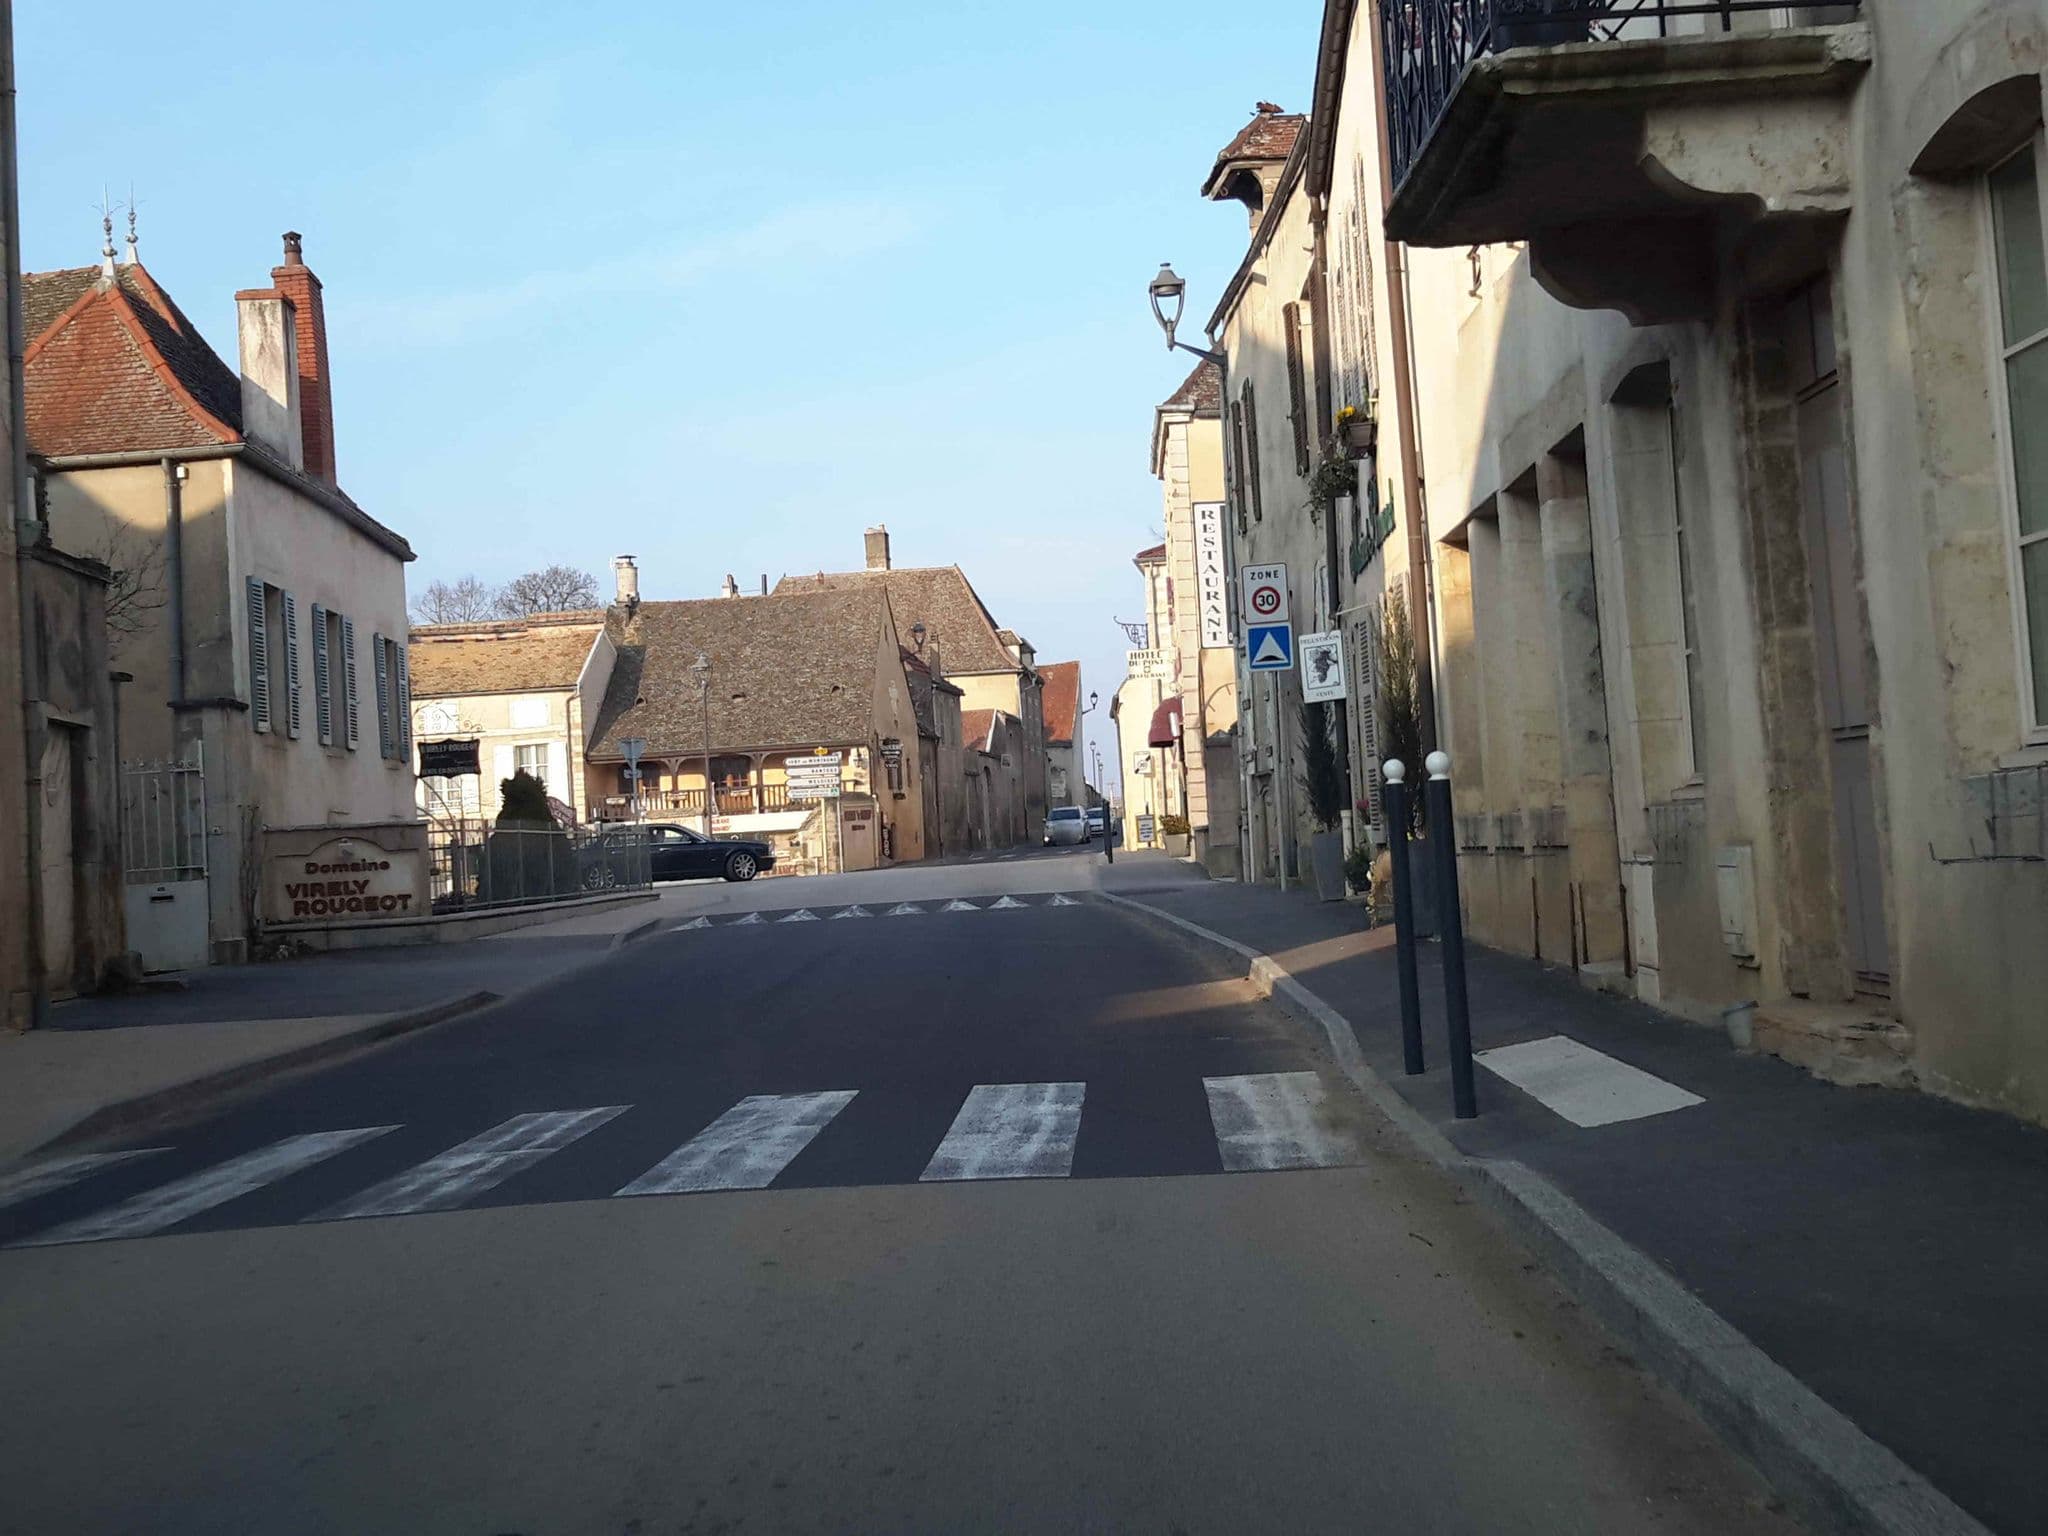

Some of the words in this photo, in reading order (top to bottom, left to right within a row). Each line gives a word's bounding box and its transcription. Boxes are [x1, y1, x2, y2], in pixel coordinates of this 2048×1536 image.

[1201, 510, 1222, 641] RESTAURANT
[1250, 570, 1279, 580] ZONE
[1258, 594, 1275, 607] 30
[1130, 651, 1162, 660] HOTEL
[305, 859, 390, 874] Domaine
[285, 880, 370, 898] VIRELY
[294, 894, 412, 915] ROUGEOT
